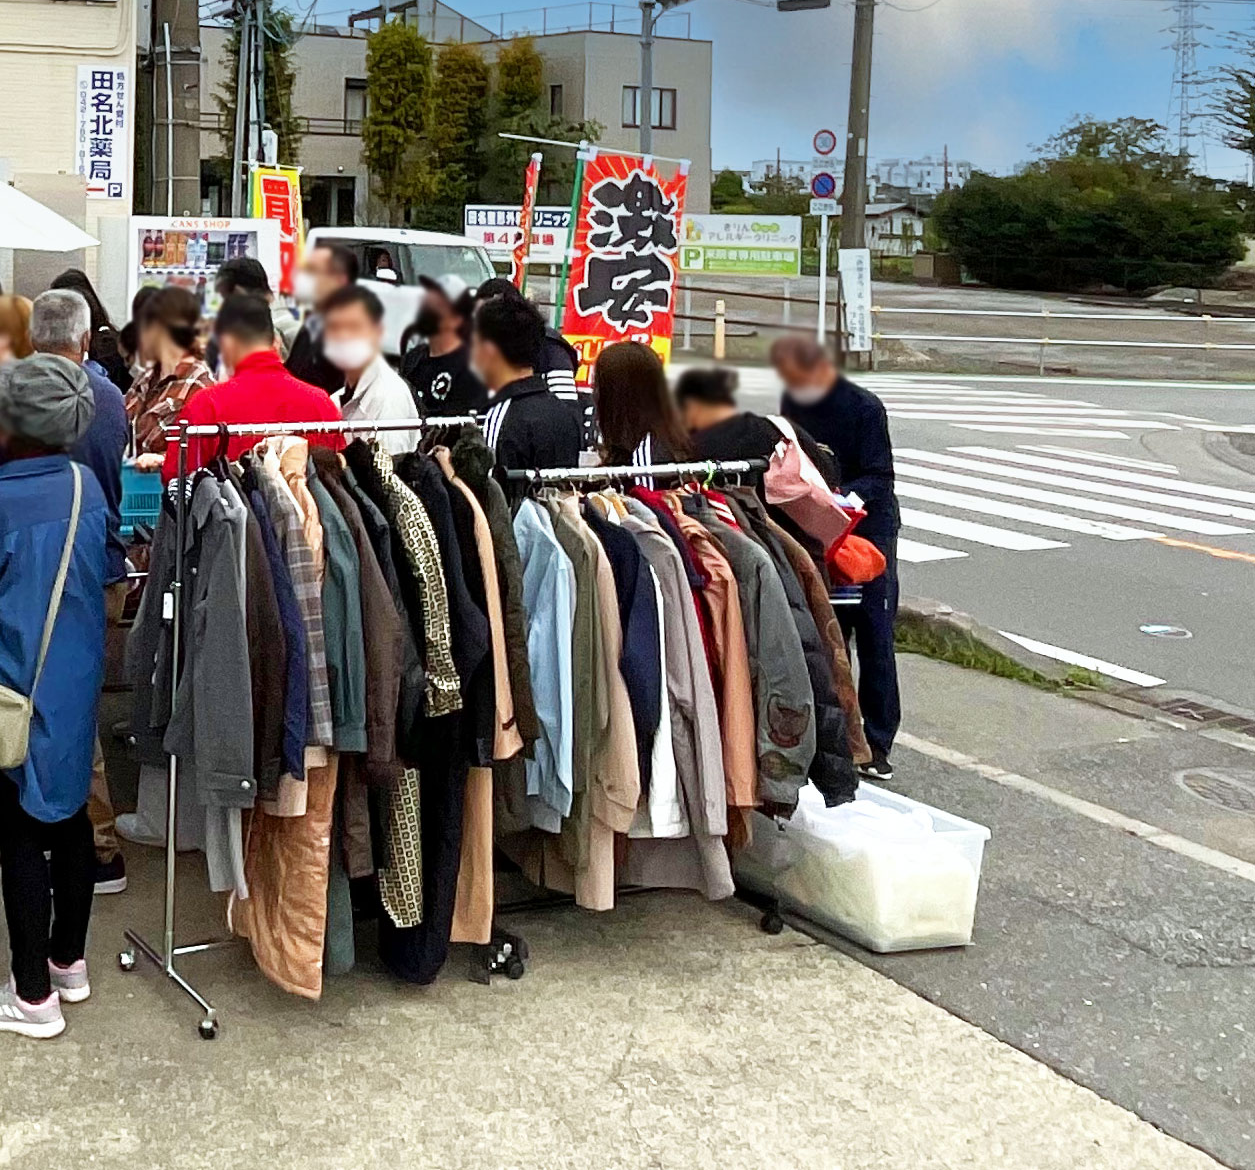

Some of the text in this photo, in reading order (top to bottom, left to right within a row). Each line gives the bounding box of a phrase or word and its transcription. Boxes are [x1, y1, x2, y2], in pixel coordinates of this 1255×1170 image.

[89, 71, 113, 180] 田名北薬局
[109, 184, 121, 197] P
[171, 220, 231, 229] CANS SHOP
[575, 170, 677, 332] 激安
[684, 248, 701, 268] P
